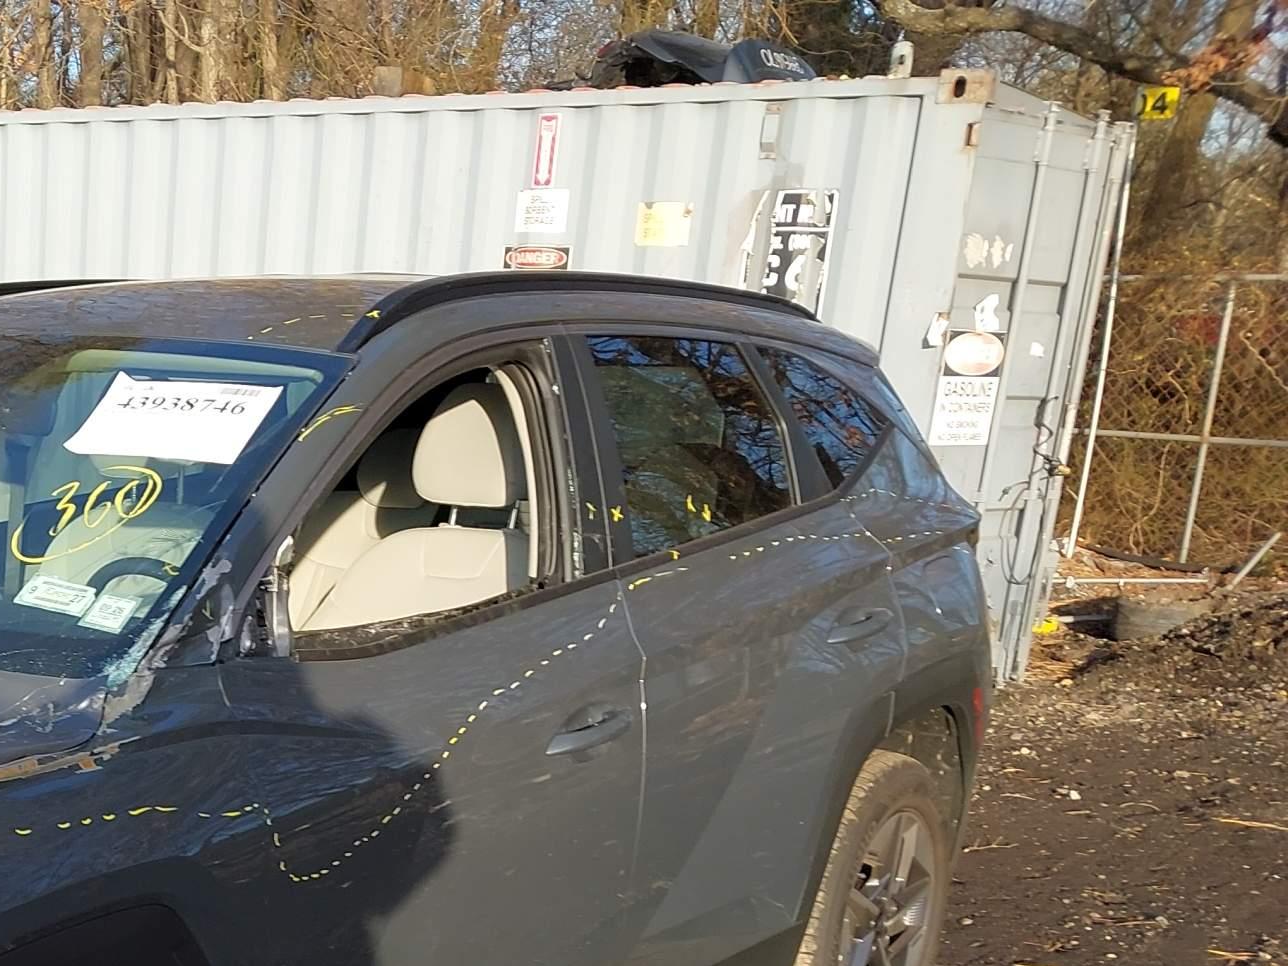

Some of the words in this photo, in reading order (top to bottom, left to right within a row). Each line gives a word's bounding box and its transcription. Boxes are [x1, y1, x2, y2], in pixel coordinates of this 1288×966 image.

[510, 252, 562, 265] DANGER
[943, 381, 993, 397] GASOLINE
[117, 396, 247, 415] 43938746
[49, 480, 154, 536] 360
